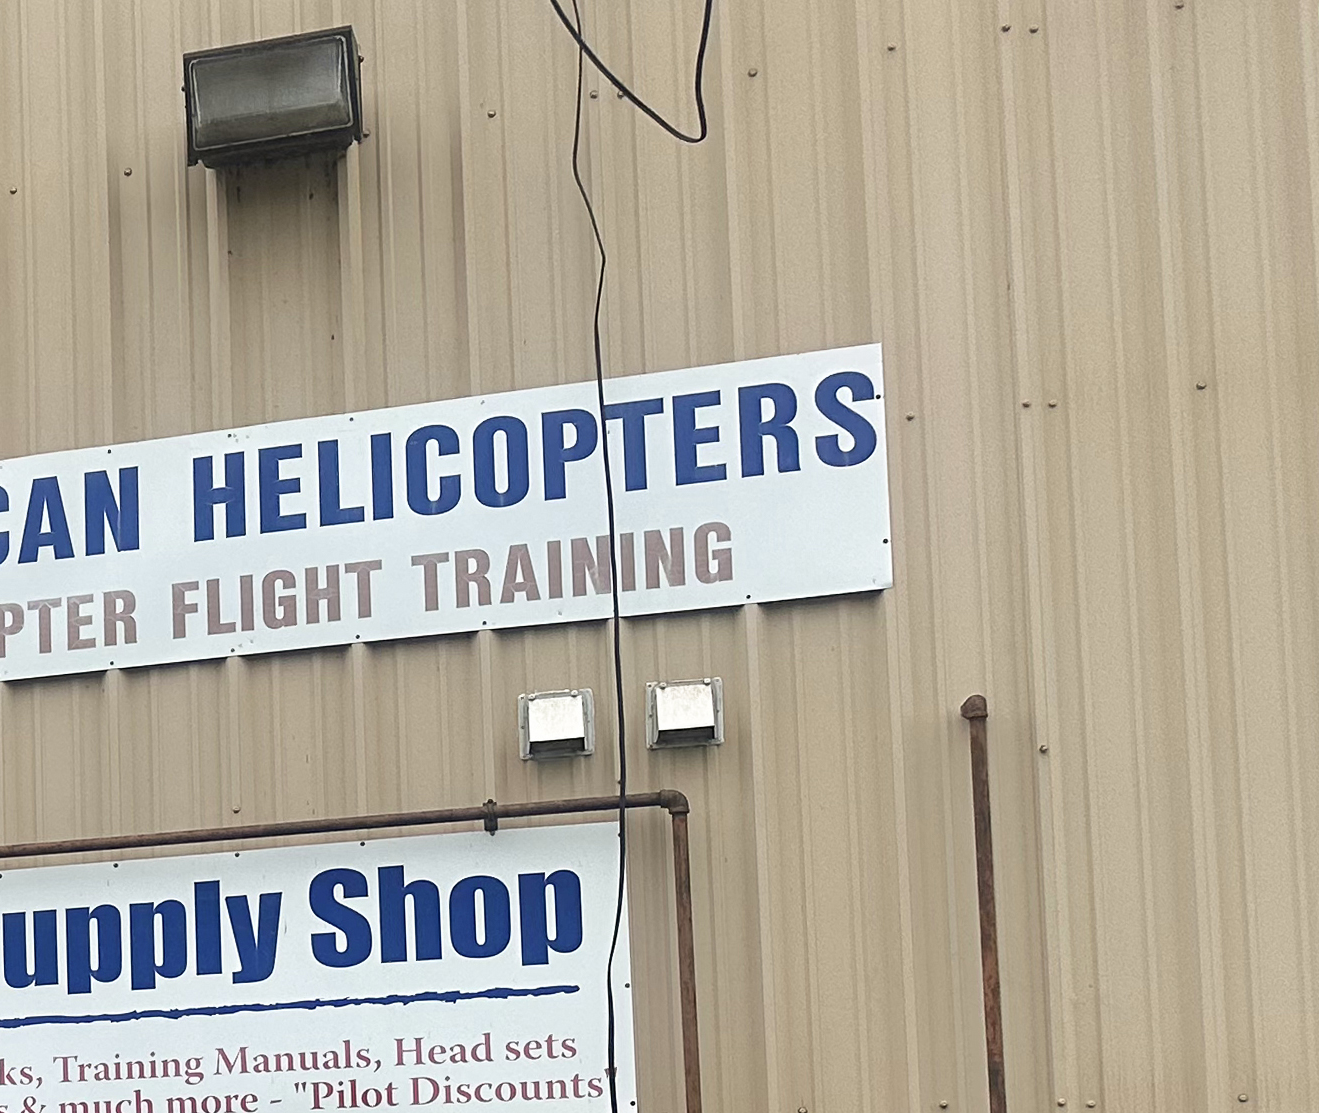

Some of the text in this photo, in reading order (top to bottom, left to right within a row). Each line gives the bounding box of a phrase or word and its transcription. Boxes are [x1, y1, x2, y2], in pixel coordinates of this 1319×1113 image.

[192, 370, 879, 543] HELICOPTERS
[171, 558, 383, 641] FLIGHT
[410, 521, 735, 612] TRAINING
[308, 863, 584, 968] Shop
[52, 1050, 206, 1086] Training
[213, 1039, 383, 1077] Manuals,
[393, 1032, 493, 1068] Head
[504, 1033, 578, 1063] sets
[294, 1079, 400, 1111] "Pilot
